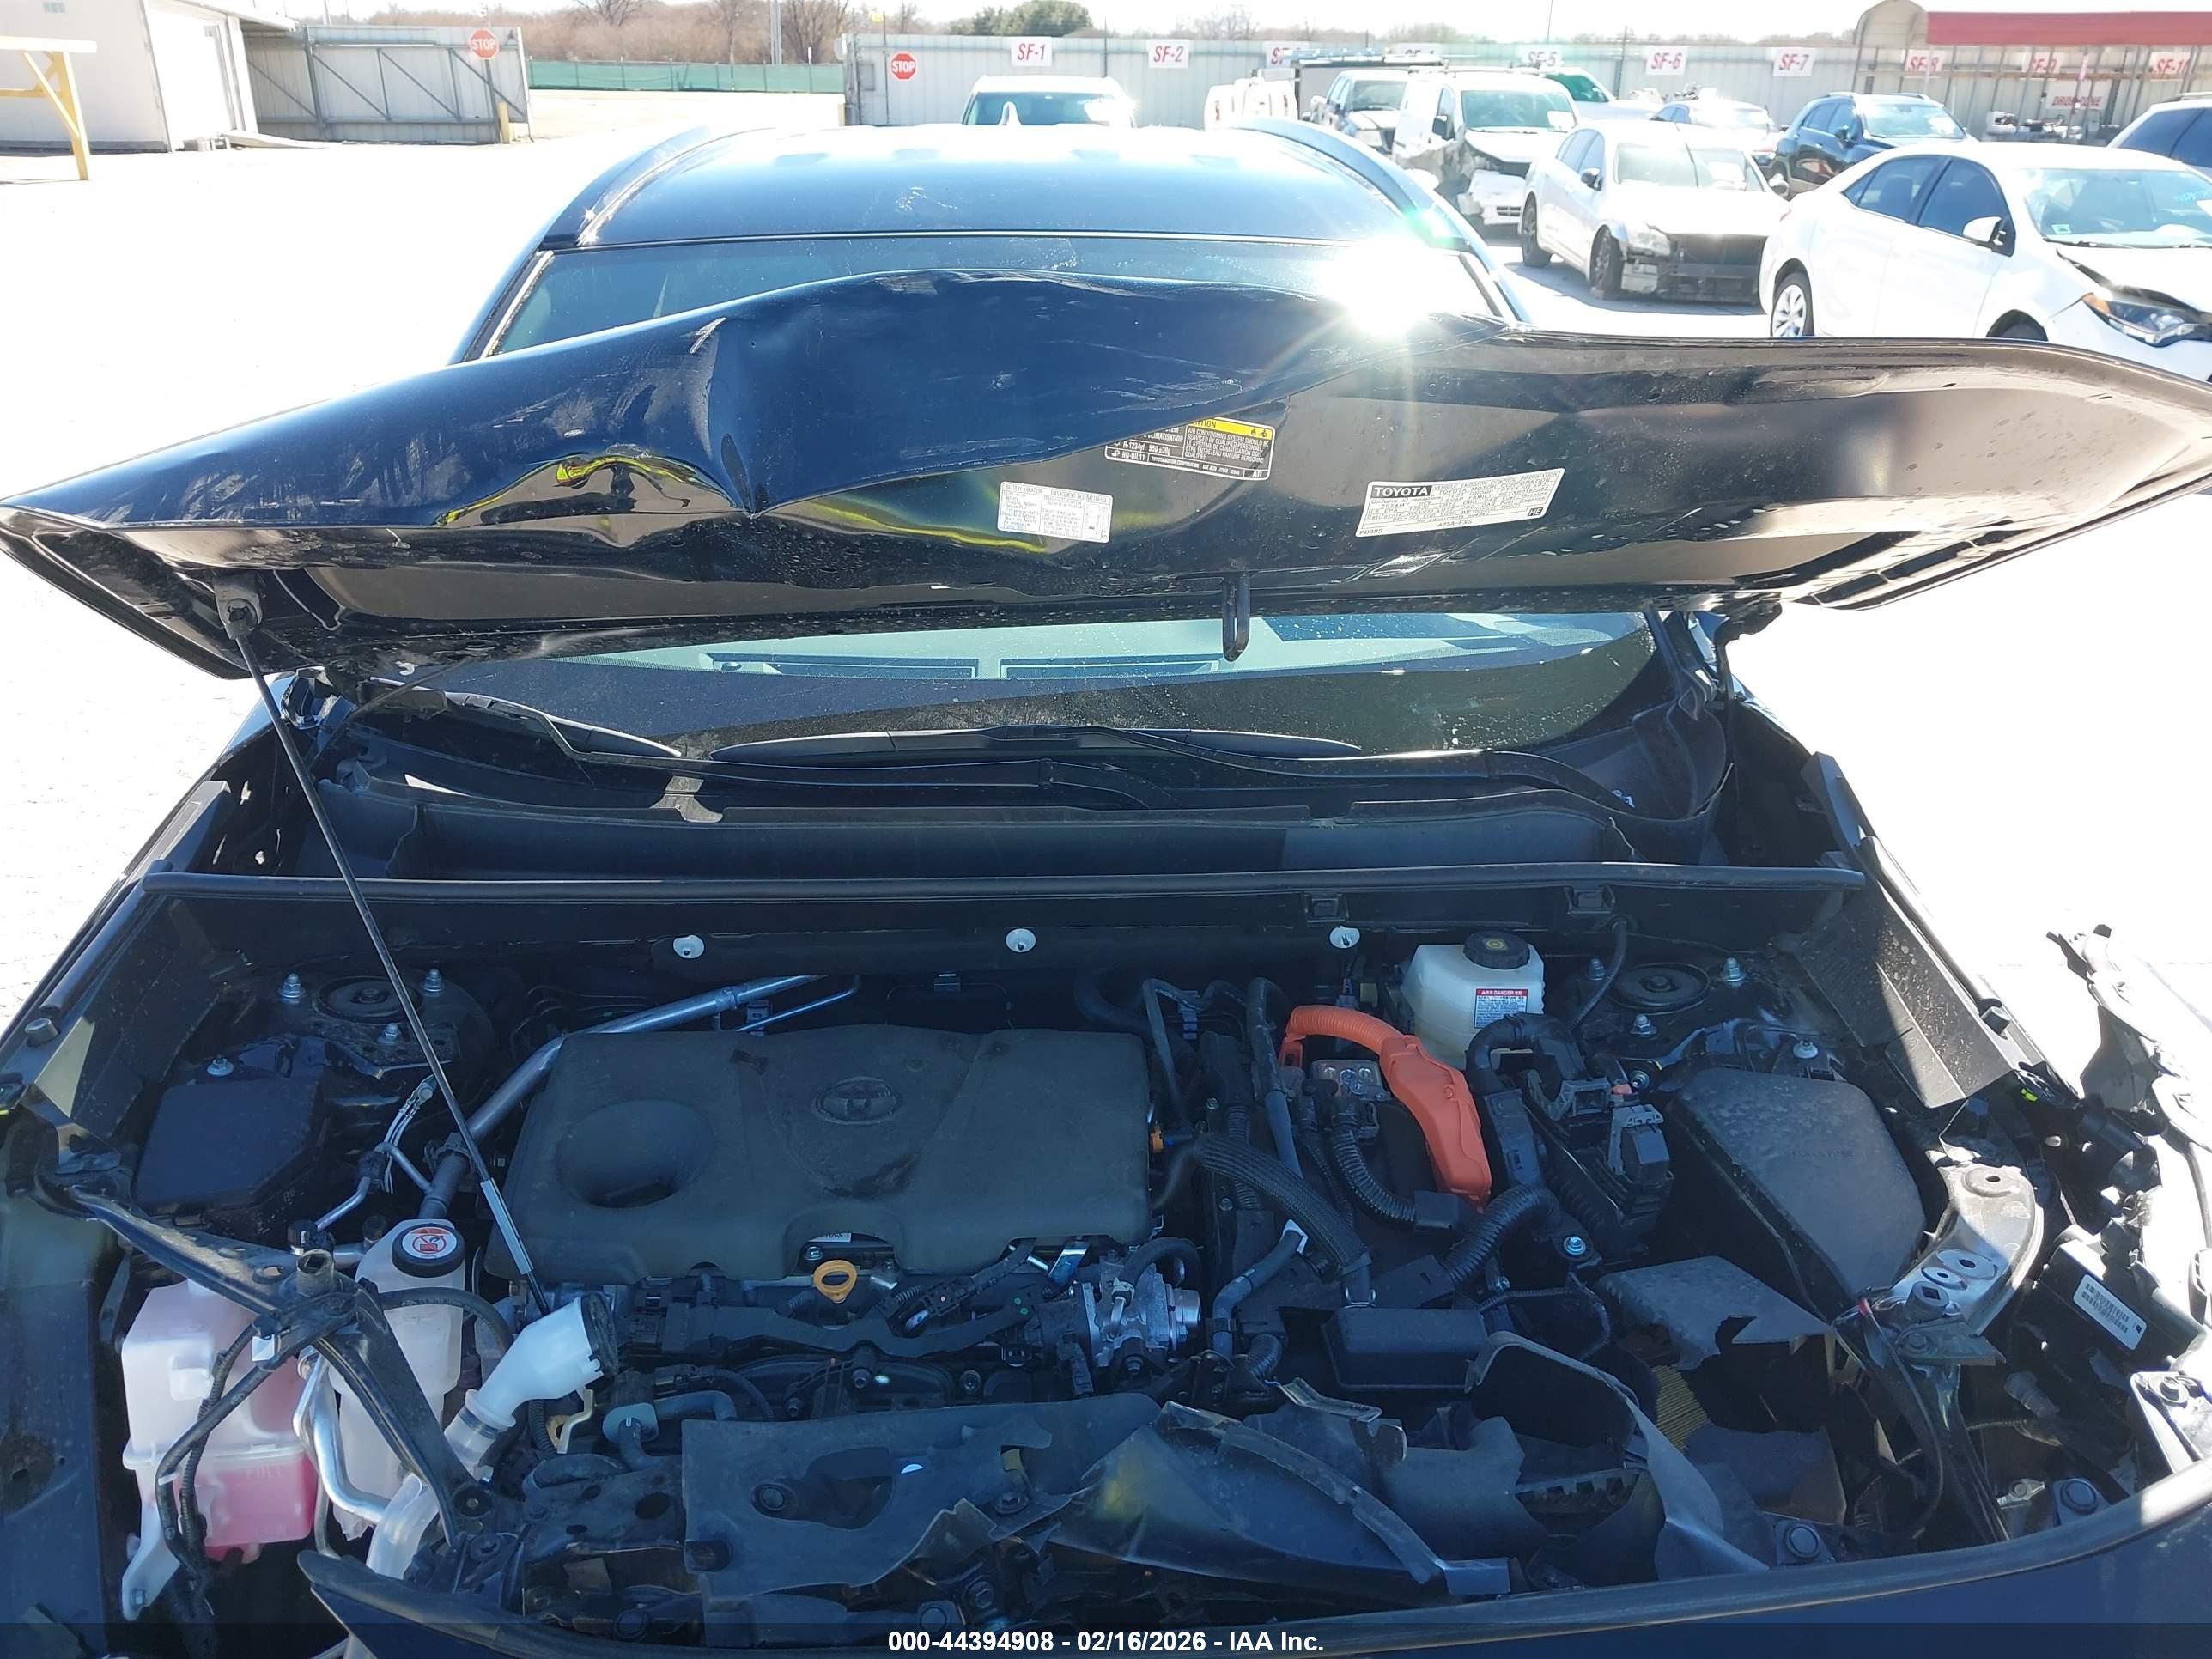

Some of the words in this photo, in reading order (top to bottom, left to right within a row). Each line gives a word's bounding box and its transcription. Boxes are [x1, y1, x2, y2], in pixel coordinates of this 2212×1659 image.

[472, 38, 495, 50] STOP
[1017, 43, 1045, 61] SF-1
[1153, 45, 1183, 63] SF-2
[891, 60, 915, 73] STOP
[1651, 52, 1682, 70] SF-6
[1778, 53, 1809, 70] SF-7
[1122, 441, 1145, 452] R-1234yf
[1148, 444, 1158, 453] 550
[1374, 487, 1429, 497] TOYOTA
[1529, 507, 1541, 516] HE
